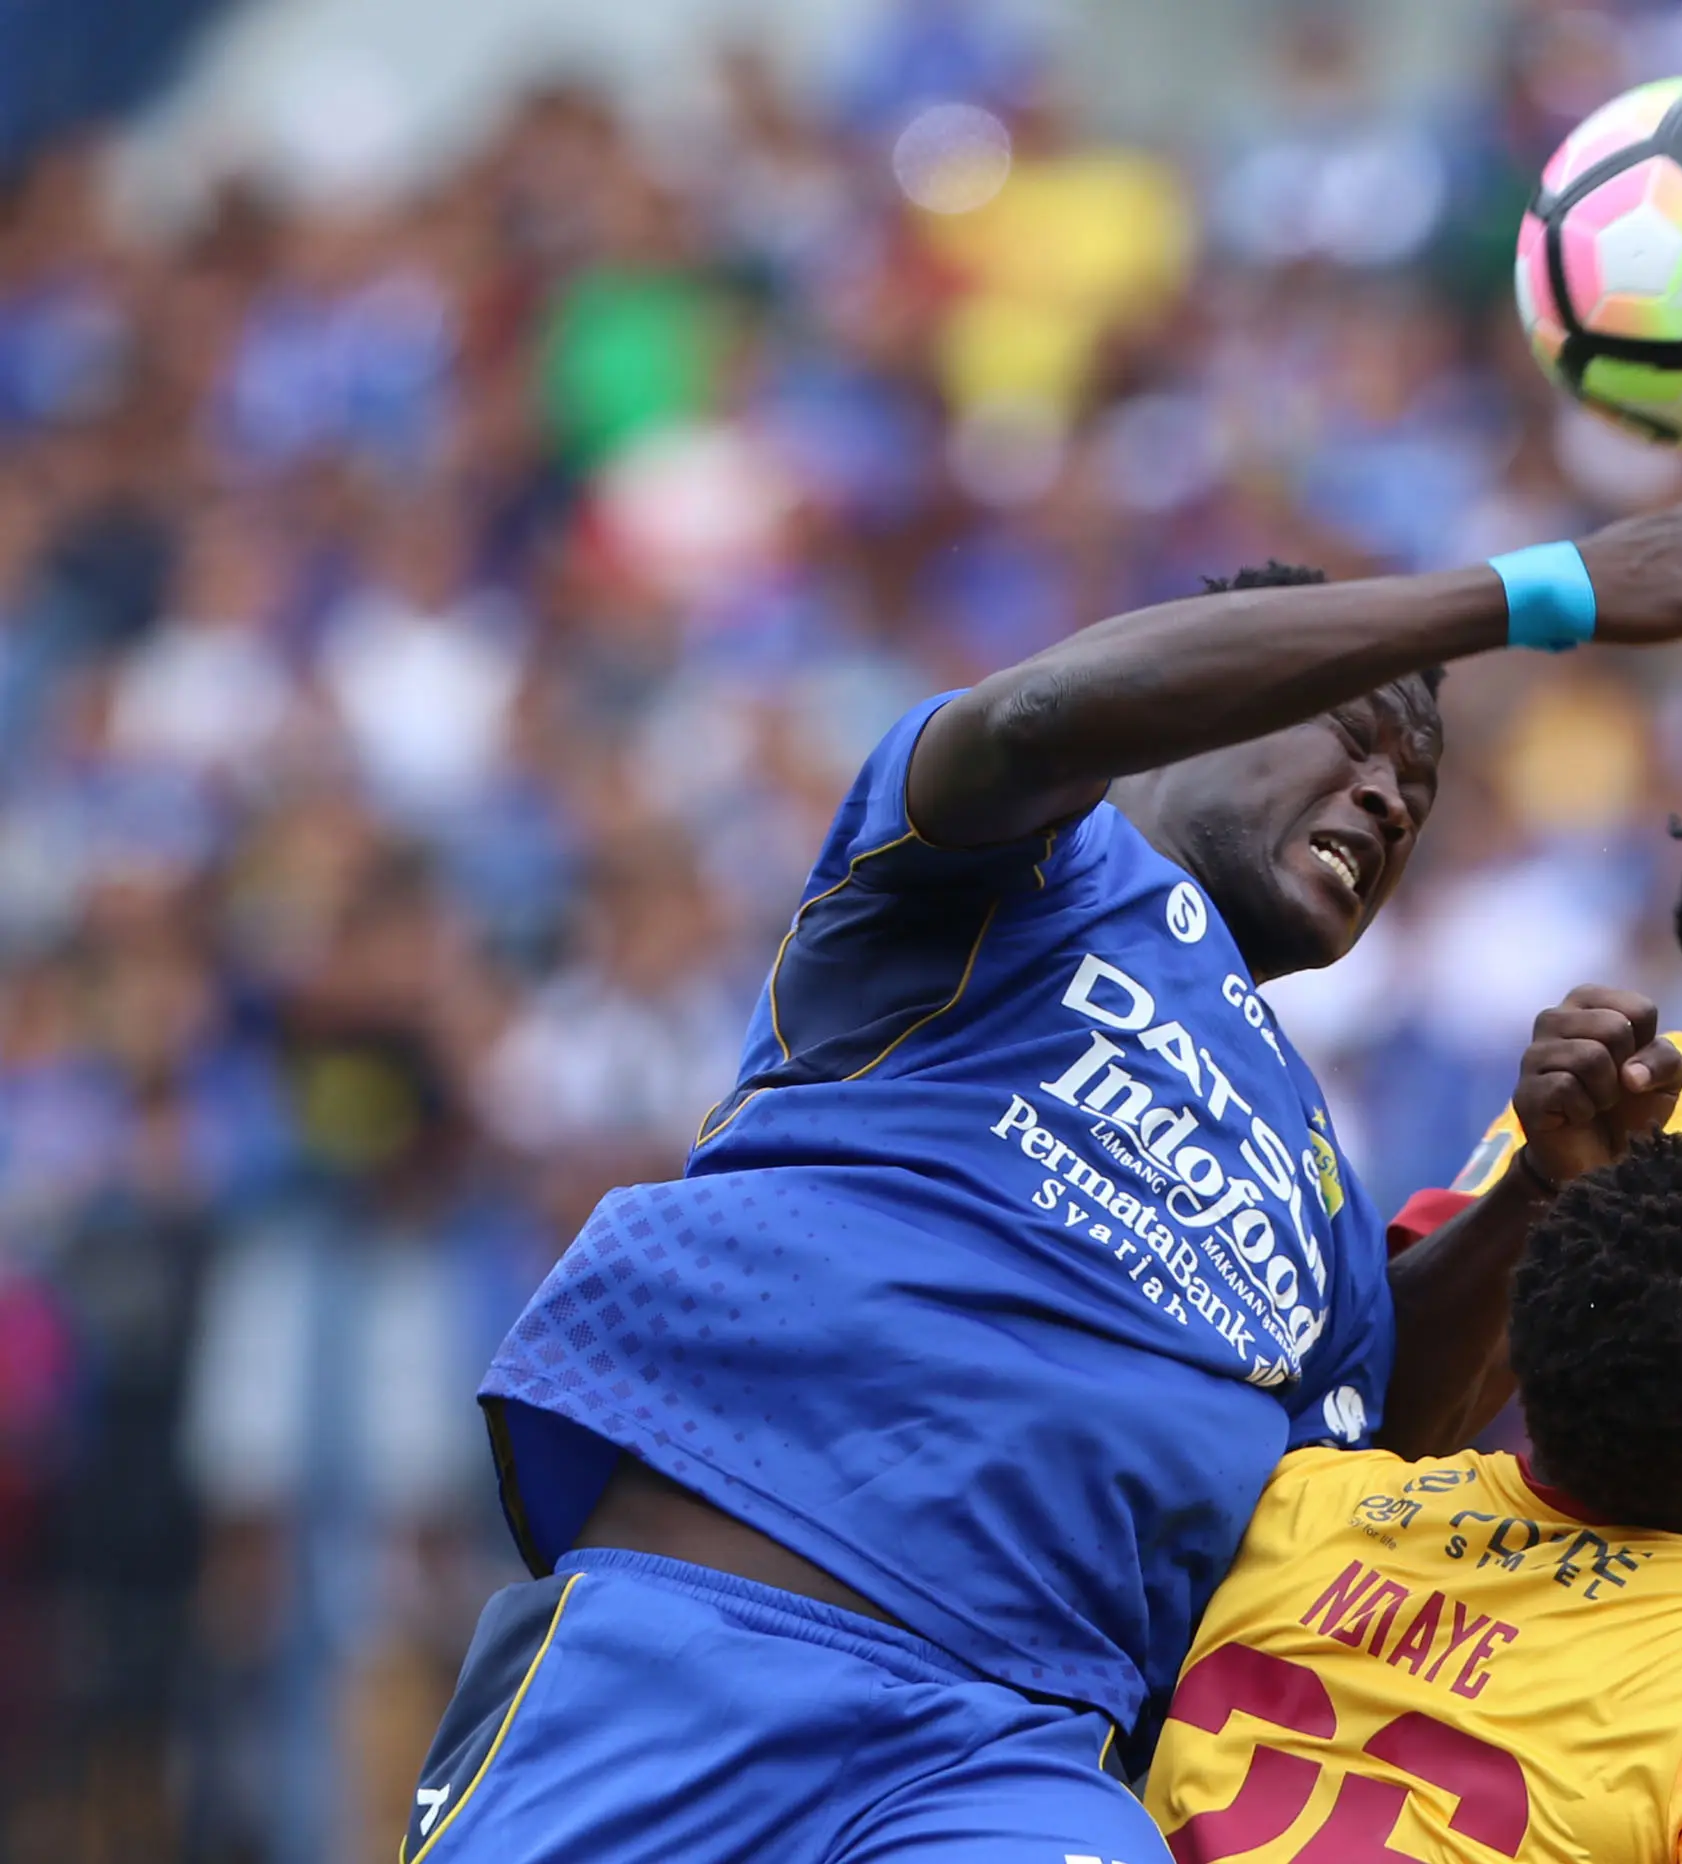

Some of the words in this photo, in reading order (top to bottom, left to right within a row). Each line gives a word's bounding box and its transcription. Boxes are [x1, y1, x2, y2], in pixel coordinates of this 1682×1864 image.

[989, 1094, 1256, 1360] PermataBank
[1032, 1178, 1189, 1326] Syariah
[1039, 1030, 1329, 1357] Indofood
[1089, 1121, 1167, 1194] LAMBANG
[1200, 1236, 1266, 1317] MAKANAN
